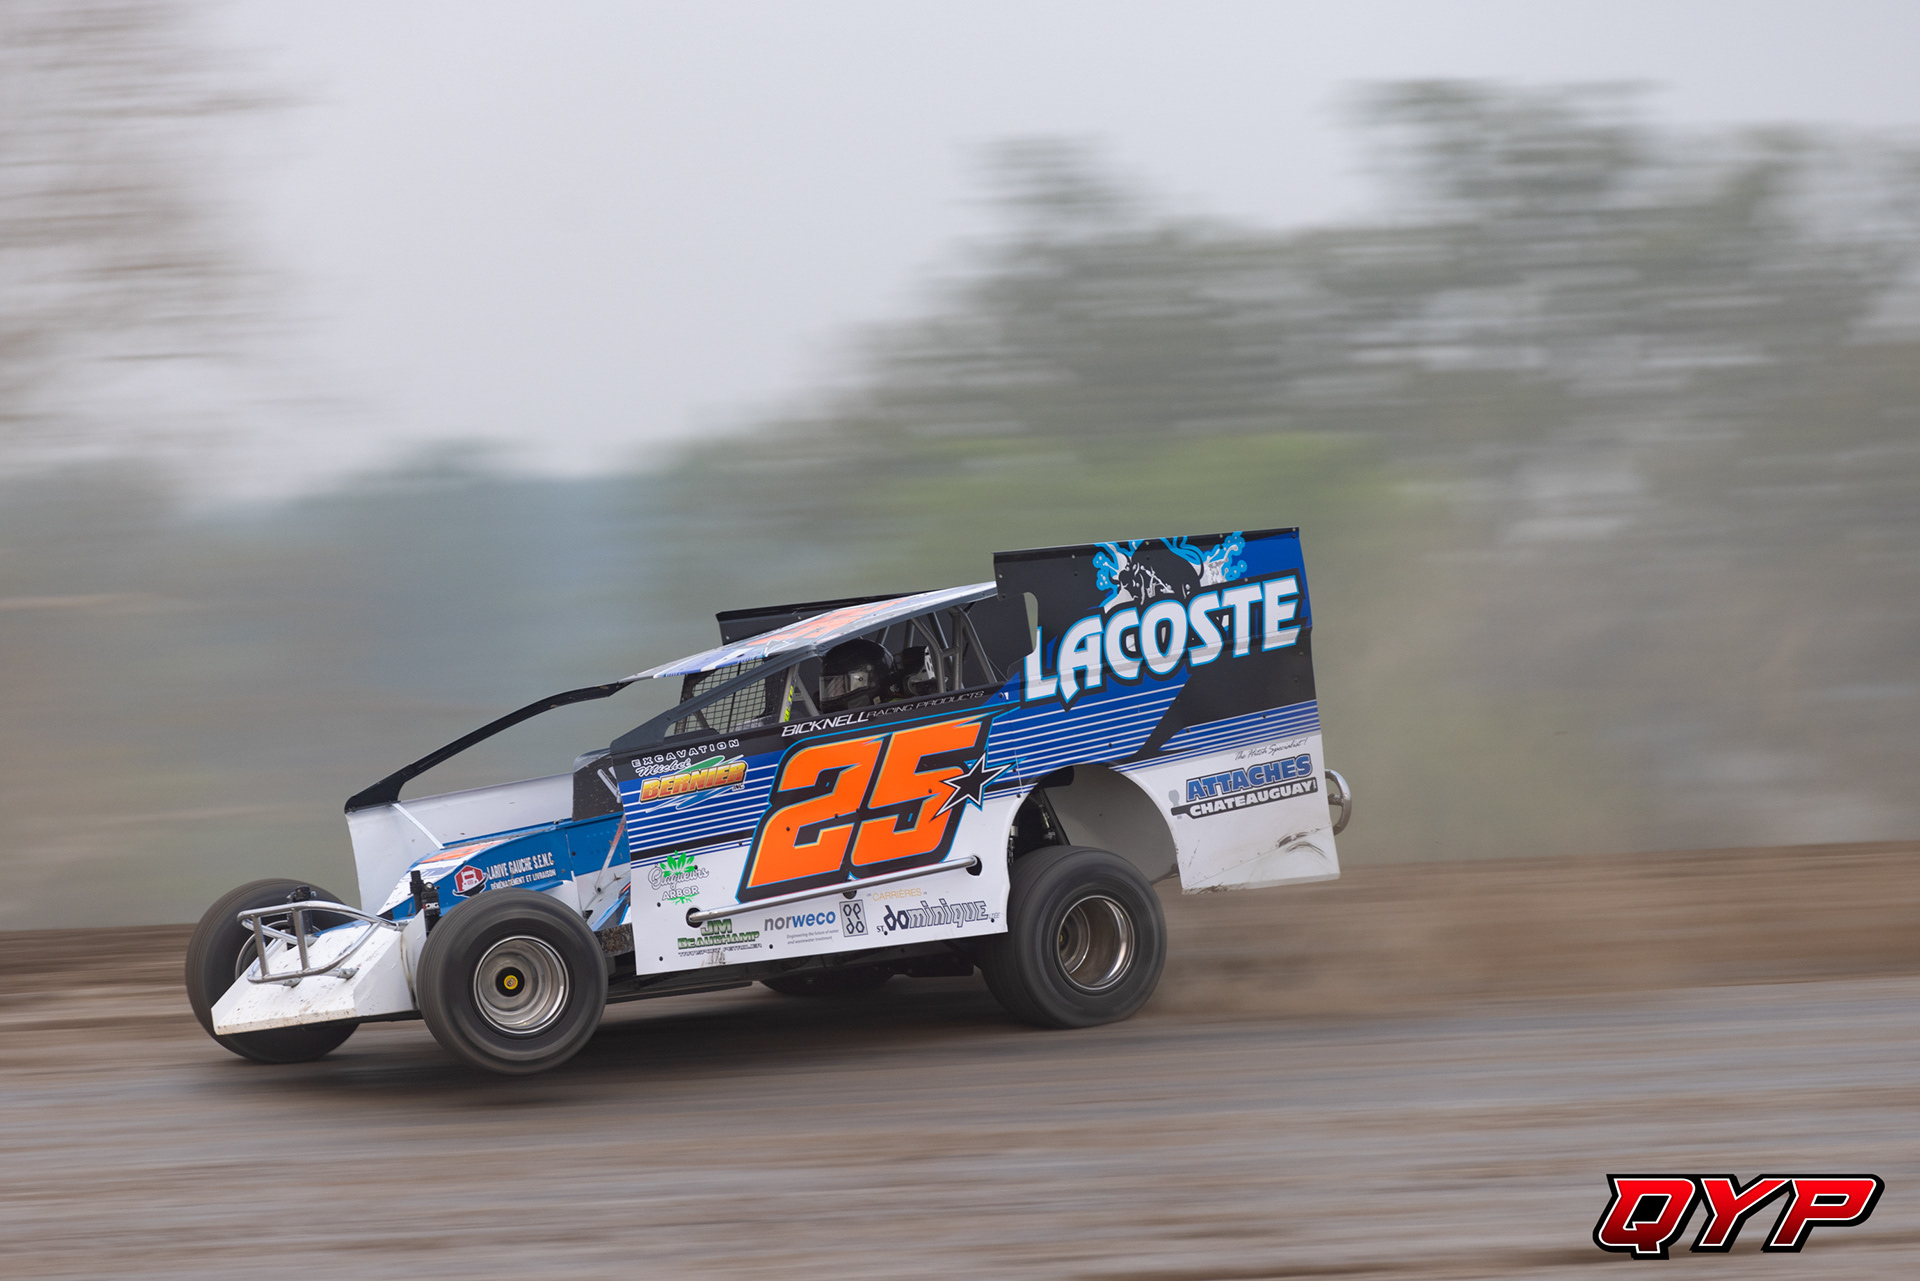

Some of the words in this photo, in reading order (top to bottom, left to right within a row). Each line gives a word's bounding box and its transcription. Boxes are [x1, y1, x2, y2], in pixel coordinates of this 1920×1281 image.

[1022, 574, 1302, 704] LACOSTE
[782, 712, 868, 737] BICKNELL
[867, 703, 914, 718] RACING
[915, 690, 985, 709] PRODUCTS
[631, 739, 739, 768] EXCAVATION
[635, 758, 692, 777] Michel
[1186, 753, 1313, 802] ATTACHES
[640, 761, 748, 803] BERNIER
[742, 713, 988, 888] 25
[1189, 779, 1313, 818] CHATEAUGUAY
[486, 862, 509, 880] LARIVE
[508, 856, 533, 874] GAUCHE
[525, 874, 532, 882] ET
[532, 869, 556, 881] LIVRAISON
[662, 885, 700, 901] ARBOR
[701, 918, 733, 936] JM
[764, 911, 836, 932] norweco
[678, 931, 760, 949] BEAUCHAMP
